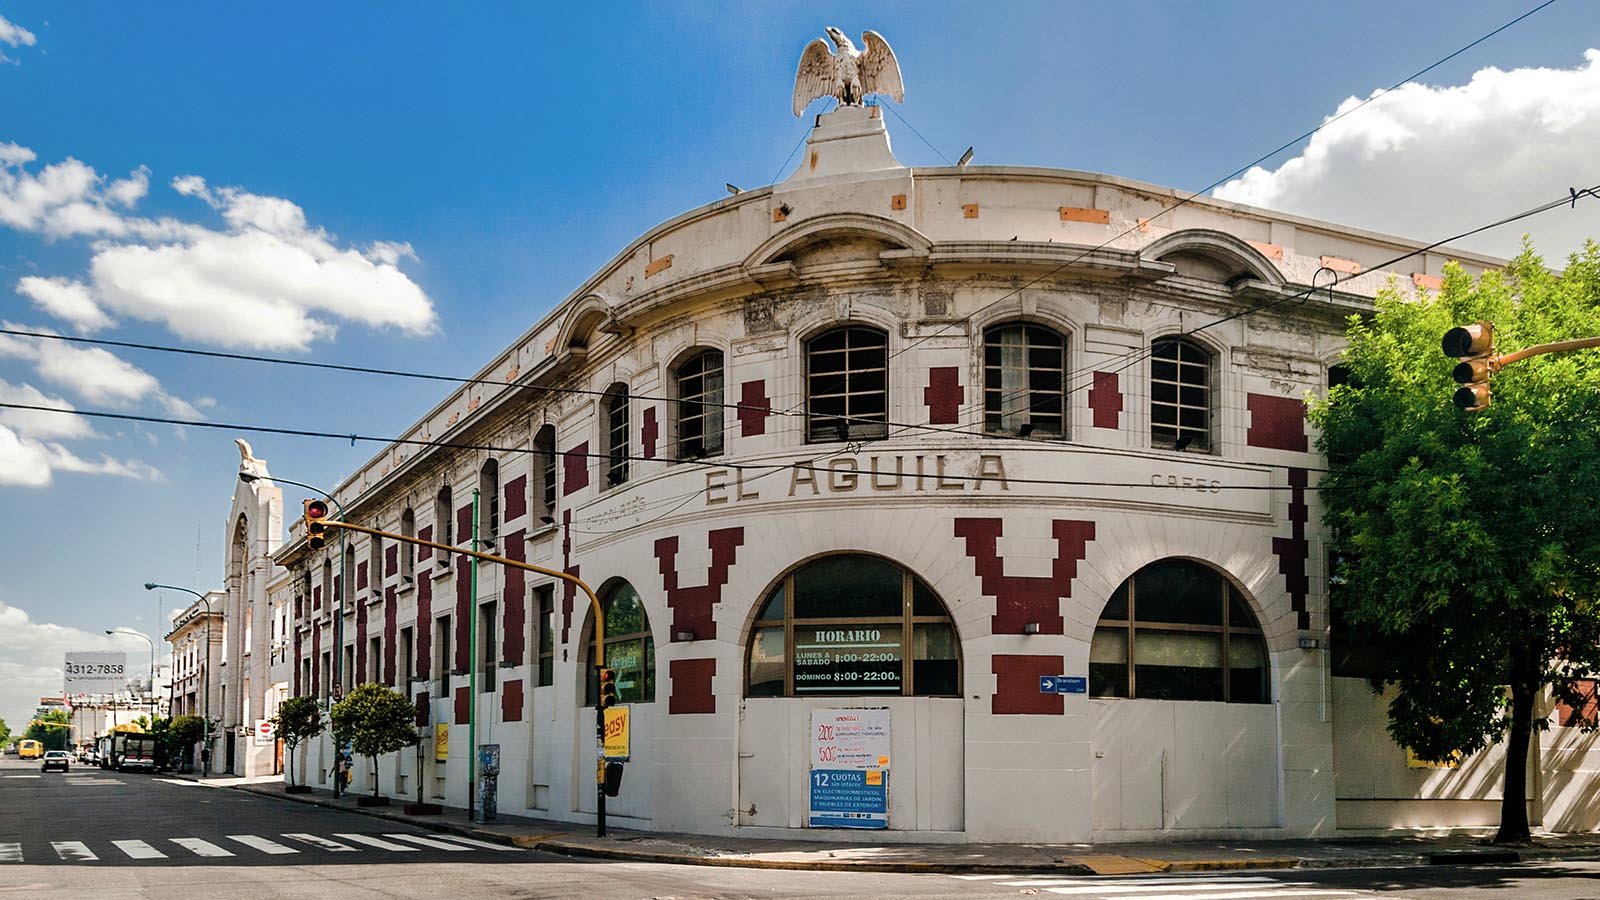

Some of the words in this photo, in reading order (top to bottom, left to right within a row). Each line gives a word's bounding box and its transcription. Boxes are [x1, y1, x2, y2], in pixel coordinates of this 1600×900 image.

[705, 466, 760, 506] EL
[787, 454, 1009, 497] AGUILA
[815, 629, 881, 643] HORARIO
[66, 664, 124, 674] 4312-7858
[796, 658, 831, 666] SABADO
[605, 714, 626, 737] easy
[818, 724, 835, 741] 20%
[819, 745, 837, 762] 50%
[814, 773, 829, 787] 12
[831, 773, 861, 781] CUOTAS
